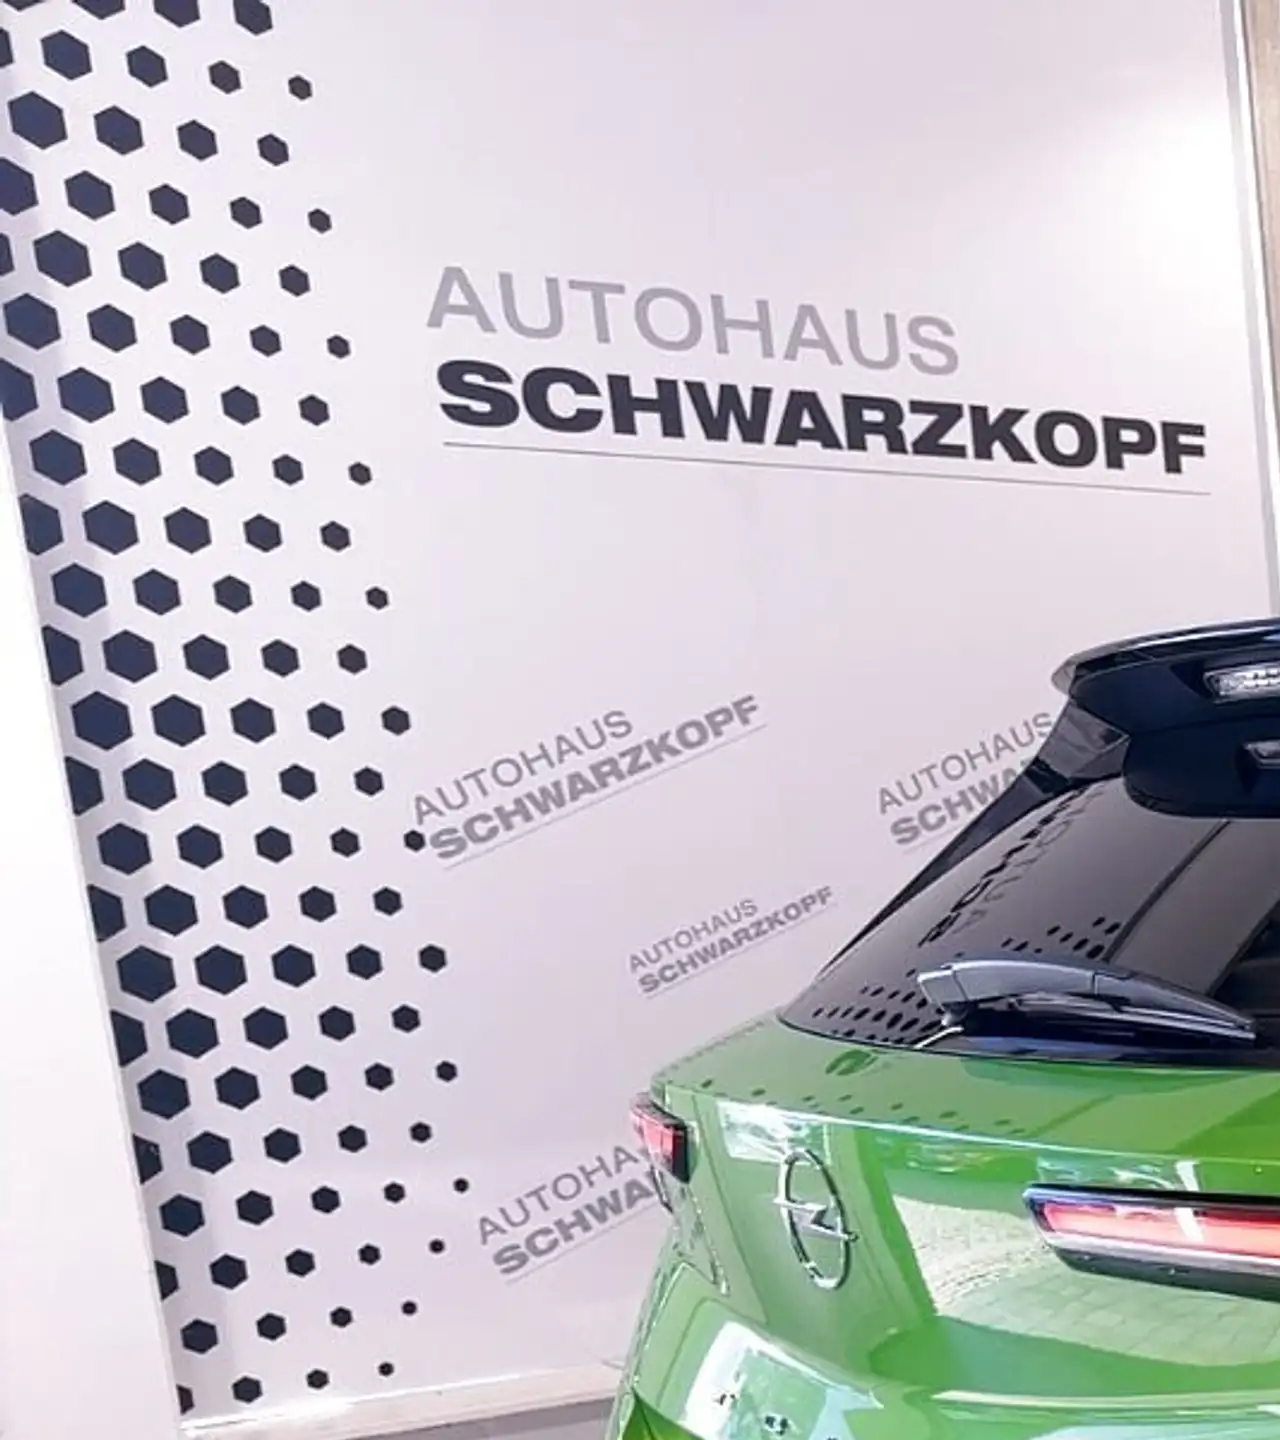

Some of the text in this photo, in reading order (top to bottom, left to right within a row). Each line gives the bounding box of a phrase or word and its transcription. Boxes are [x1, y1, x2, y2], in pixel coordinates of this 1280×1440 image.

[426, 264, 960, 378] AUTOHAUS
[436, 358, 1208, 475] SCHWARZKOPF
[412, 709, 634, 827] AUTOHAUS
[429, 696, 762, 861] SCHWARZKOPF
[877, 711, 1053, 816] AUTOHAUS
[628, 898, 759, 975] AUTOHAUS
[638, 886, 835, 995] SCHWARZKOPF
[477, 1145, 641, 1246] AUTOHA
